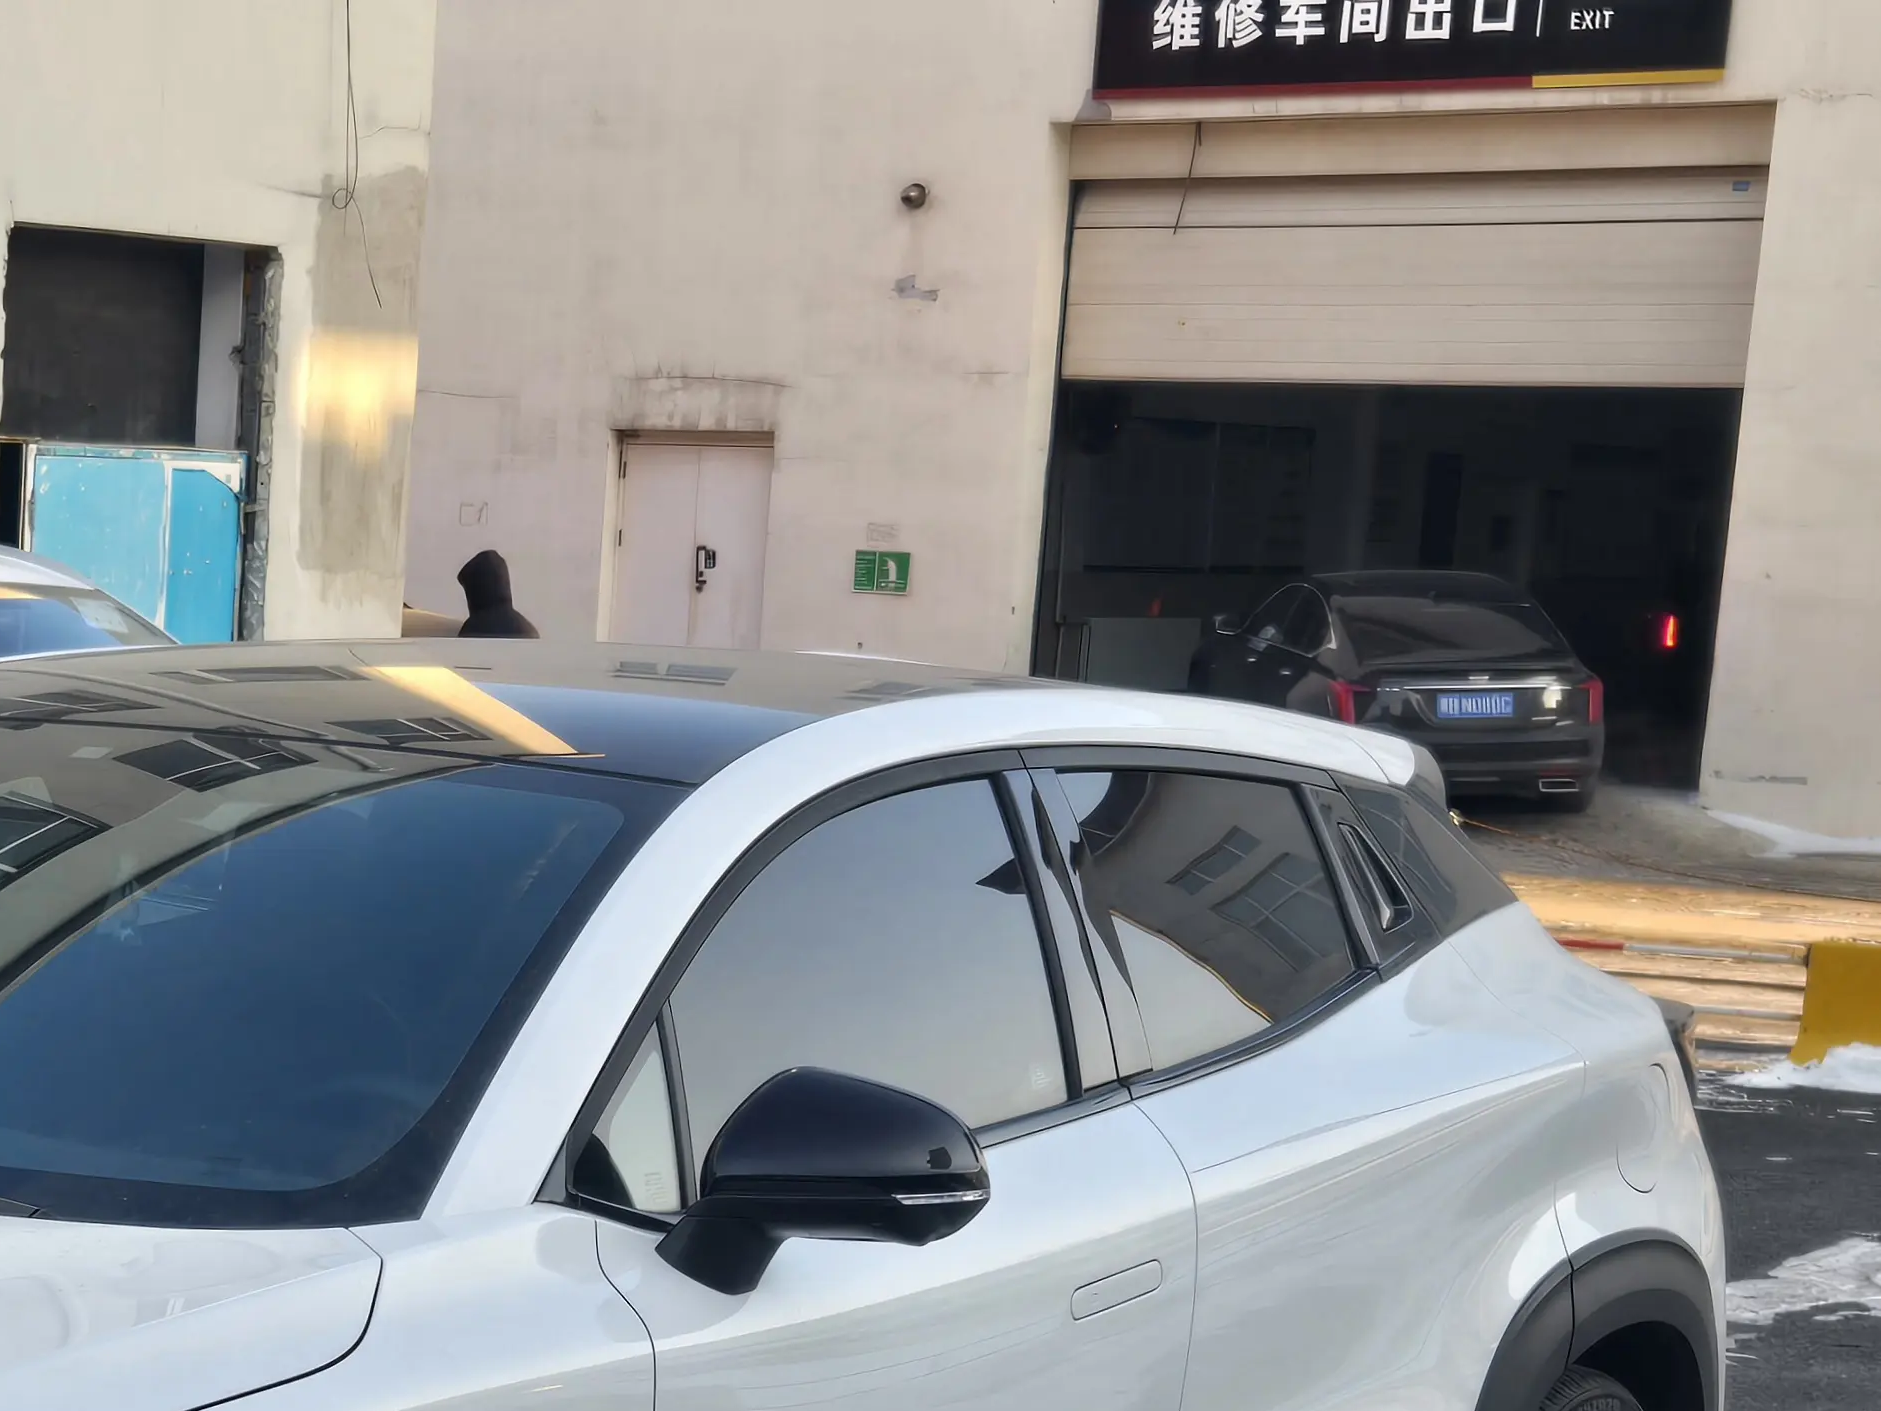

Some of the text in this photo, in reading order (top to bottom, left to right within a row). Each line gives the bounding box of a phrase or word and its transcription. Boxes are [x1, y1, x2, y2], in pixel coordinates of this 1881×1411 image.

[1152, 0, 1516, 51] 维修车间出口
[1570, 9, 1615, 31] EXIT
